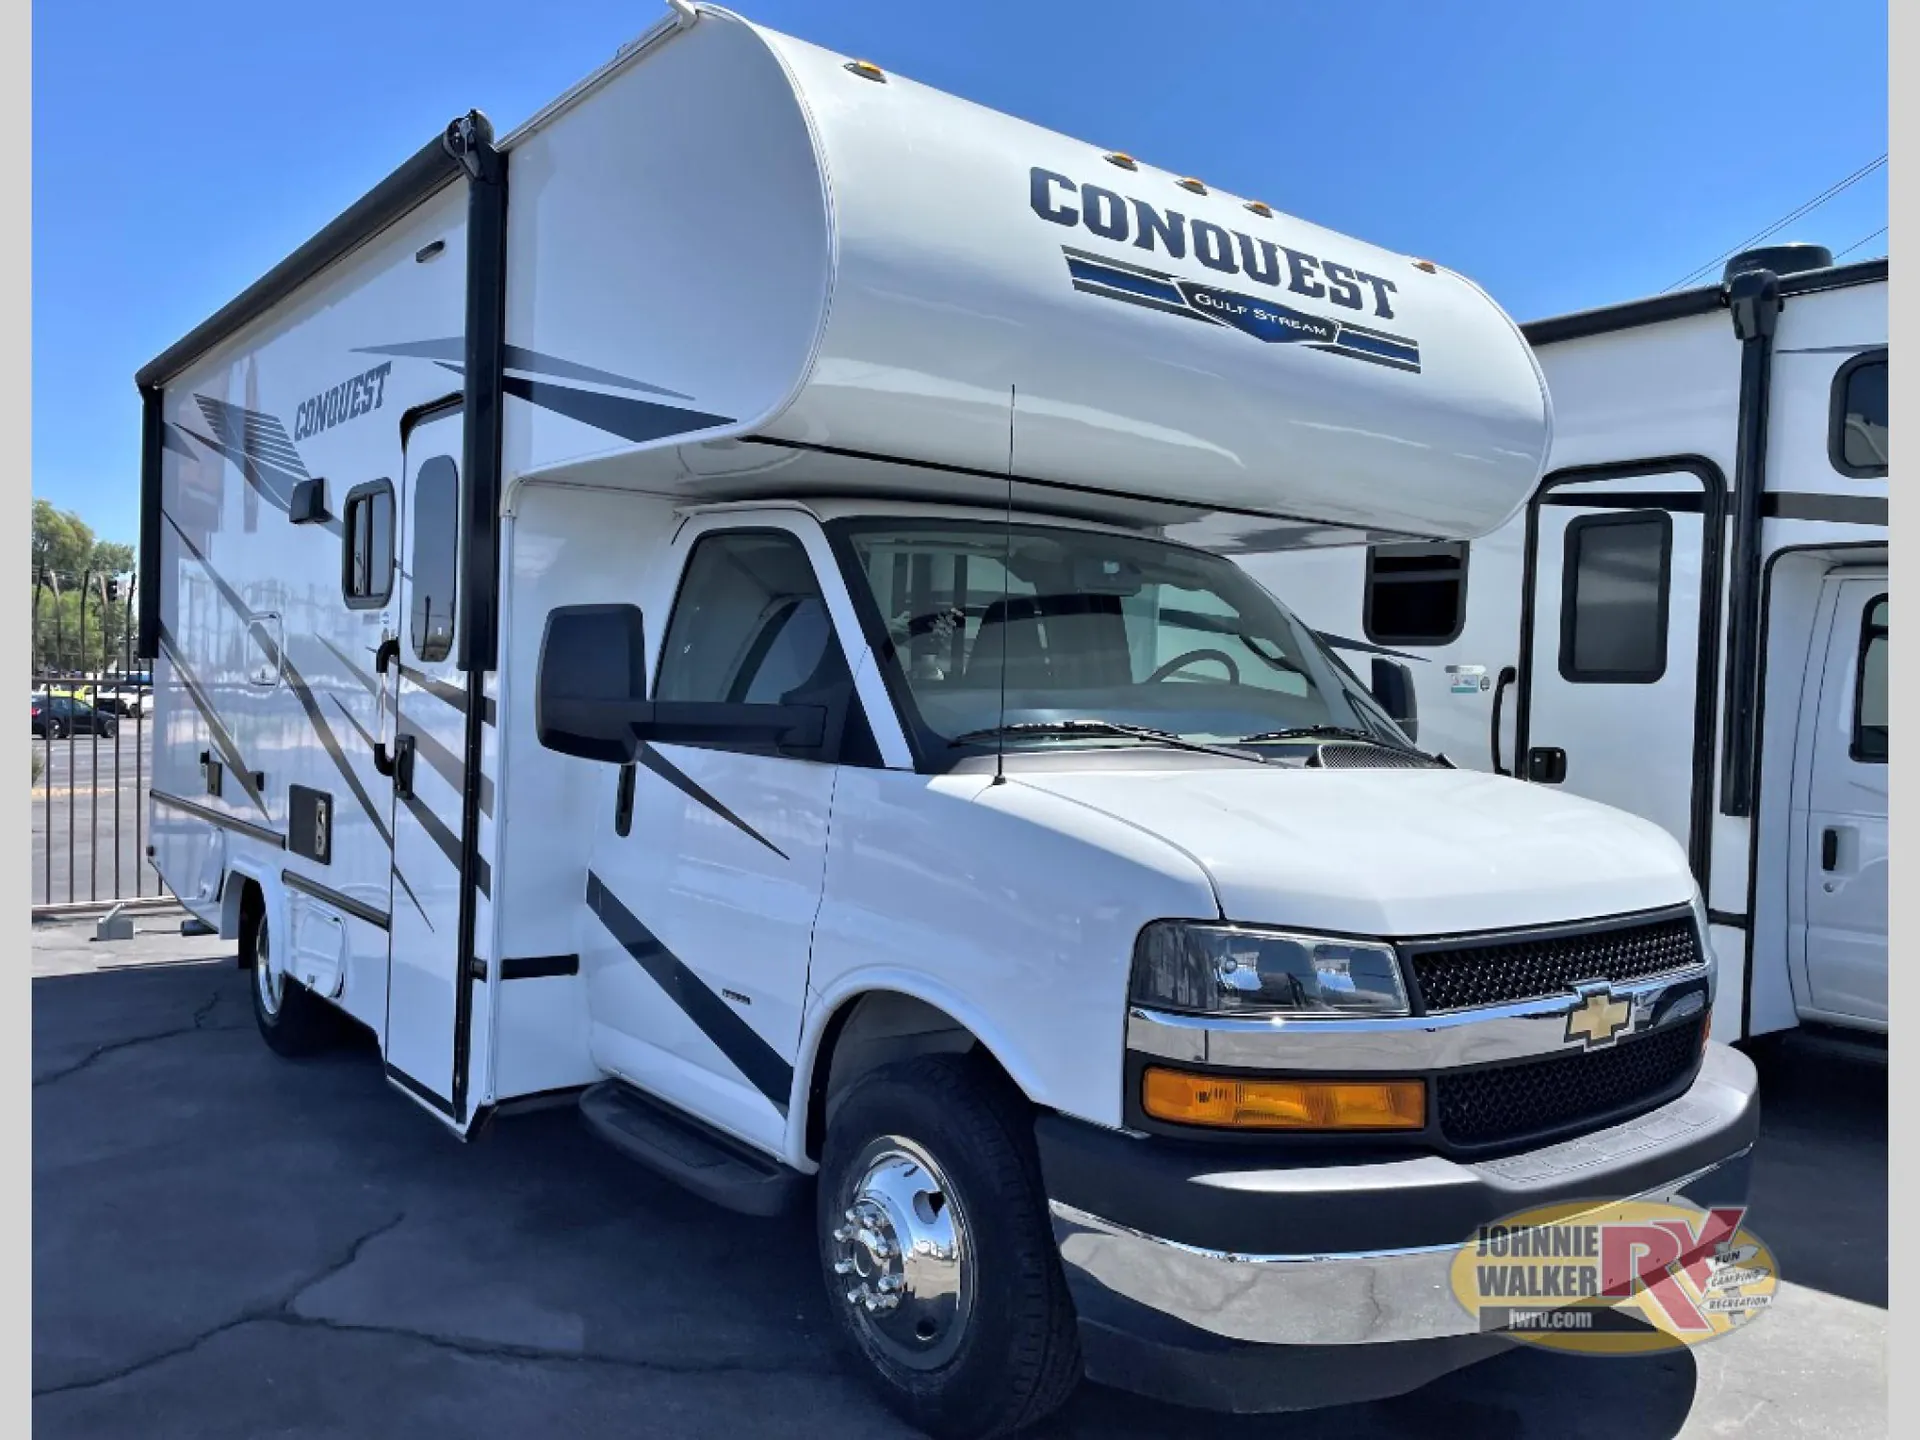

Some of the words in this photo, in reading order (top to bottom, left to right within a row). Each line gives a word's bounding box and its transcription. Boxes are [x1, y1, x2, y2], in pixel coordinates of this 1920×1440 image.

[1030, 167, 1398, 320] CONQUEST
[1194, 293, 1248, 315] GULF
[1253, 307, 1327, 336] STREAM
[294, 361, 392, 441] CONQUEST
